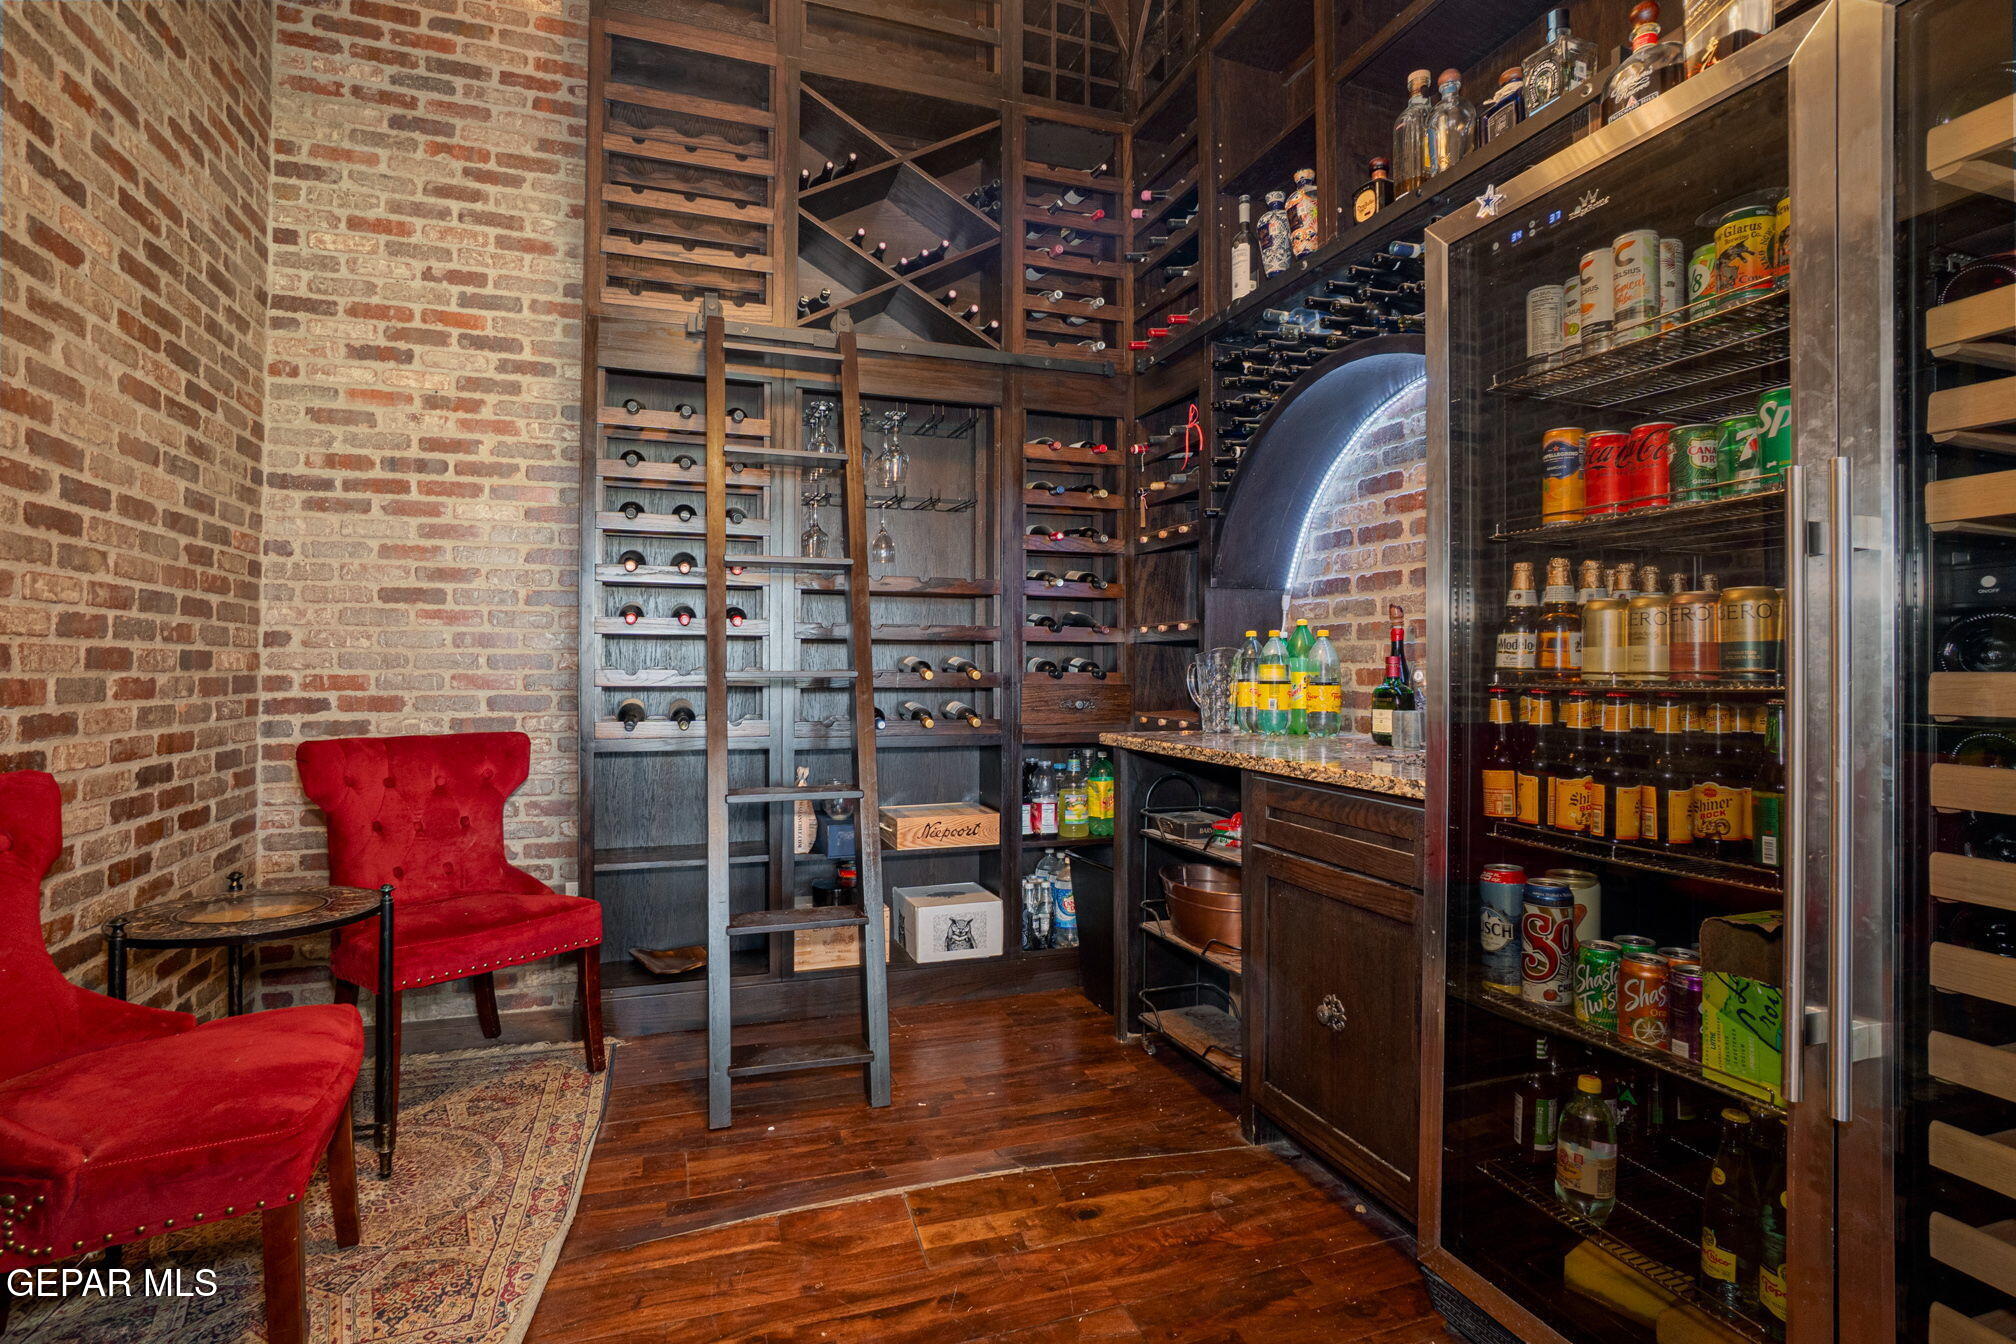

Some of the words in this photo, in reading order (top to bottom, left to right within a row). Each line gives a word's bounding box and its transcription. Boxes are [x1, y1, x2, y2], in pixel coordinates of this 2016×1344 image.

[1723, 222, 1762, 238] Glarus
[1701, 455, 1716, 464] DR
[1569, 791, 1590, 807] Shi
[1700, 810, 1727, 820] BOCK
[917, 821, 982, 842] Niepoort
[1624, 979, 1667, 1012] Shas
[1577, 990, 1618, 1018] Twis
